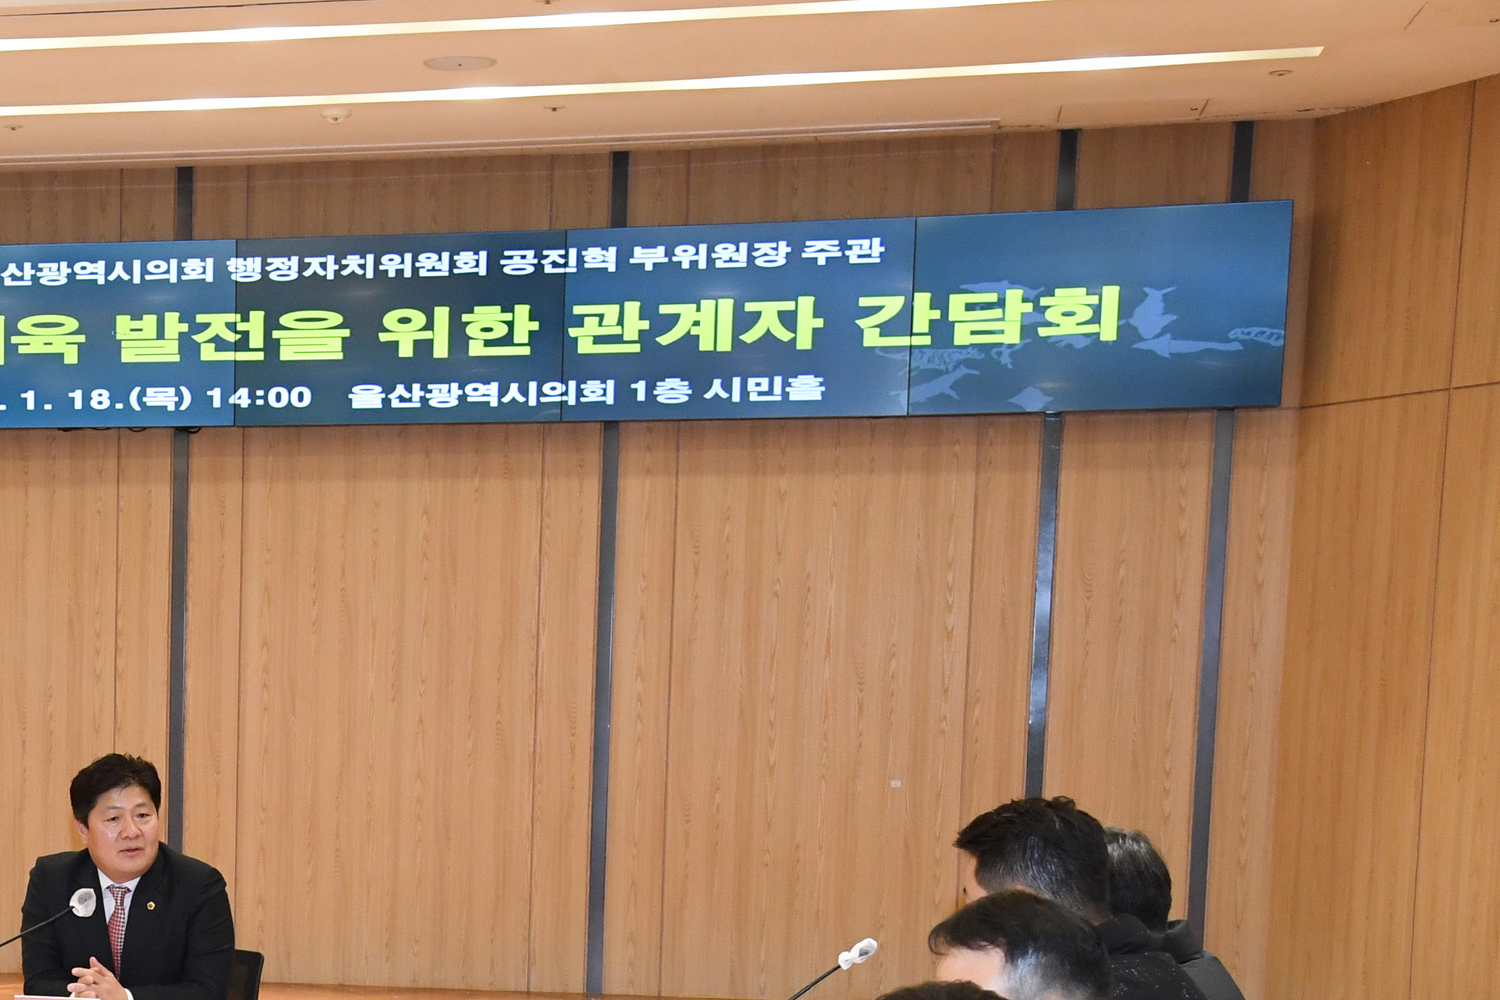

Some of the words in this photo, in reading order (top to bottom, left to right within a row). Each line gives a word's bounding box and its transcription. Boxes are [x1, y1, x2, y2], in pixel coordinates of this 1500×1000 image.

[226, 250, 487, 282] 행정자치위원회
[500, 246, 617, 275] 공진혁
[629, 240, 792, 271] 부위원장
[801, 237, 885, 266] 주관
[115, 310, 351, 363] 발전을
[378, 304, 540, 359] 위한
[567, 295, 824, 354] 관계자
[856, 285, 1121, 347] 간담회
[20, 390, 52, 410] 1.
[68, 385, 192, 411] 18.(목)
[206, 386, 312, 408] 14:00
[348, 379, 615, 409] 울산광역시의회
[630, 378, 693, 404] 1층
[703, 374, 826, 403] 시민홀
